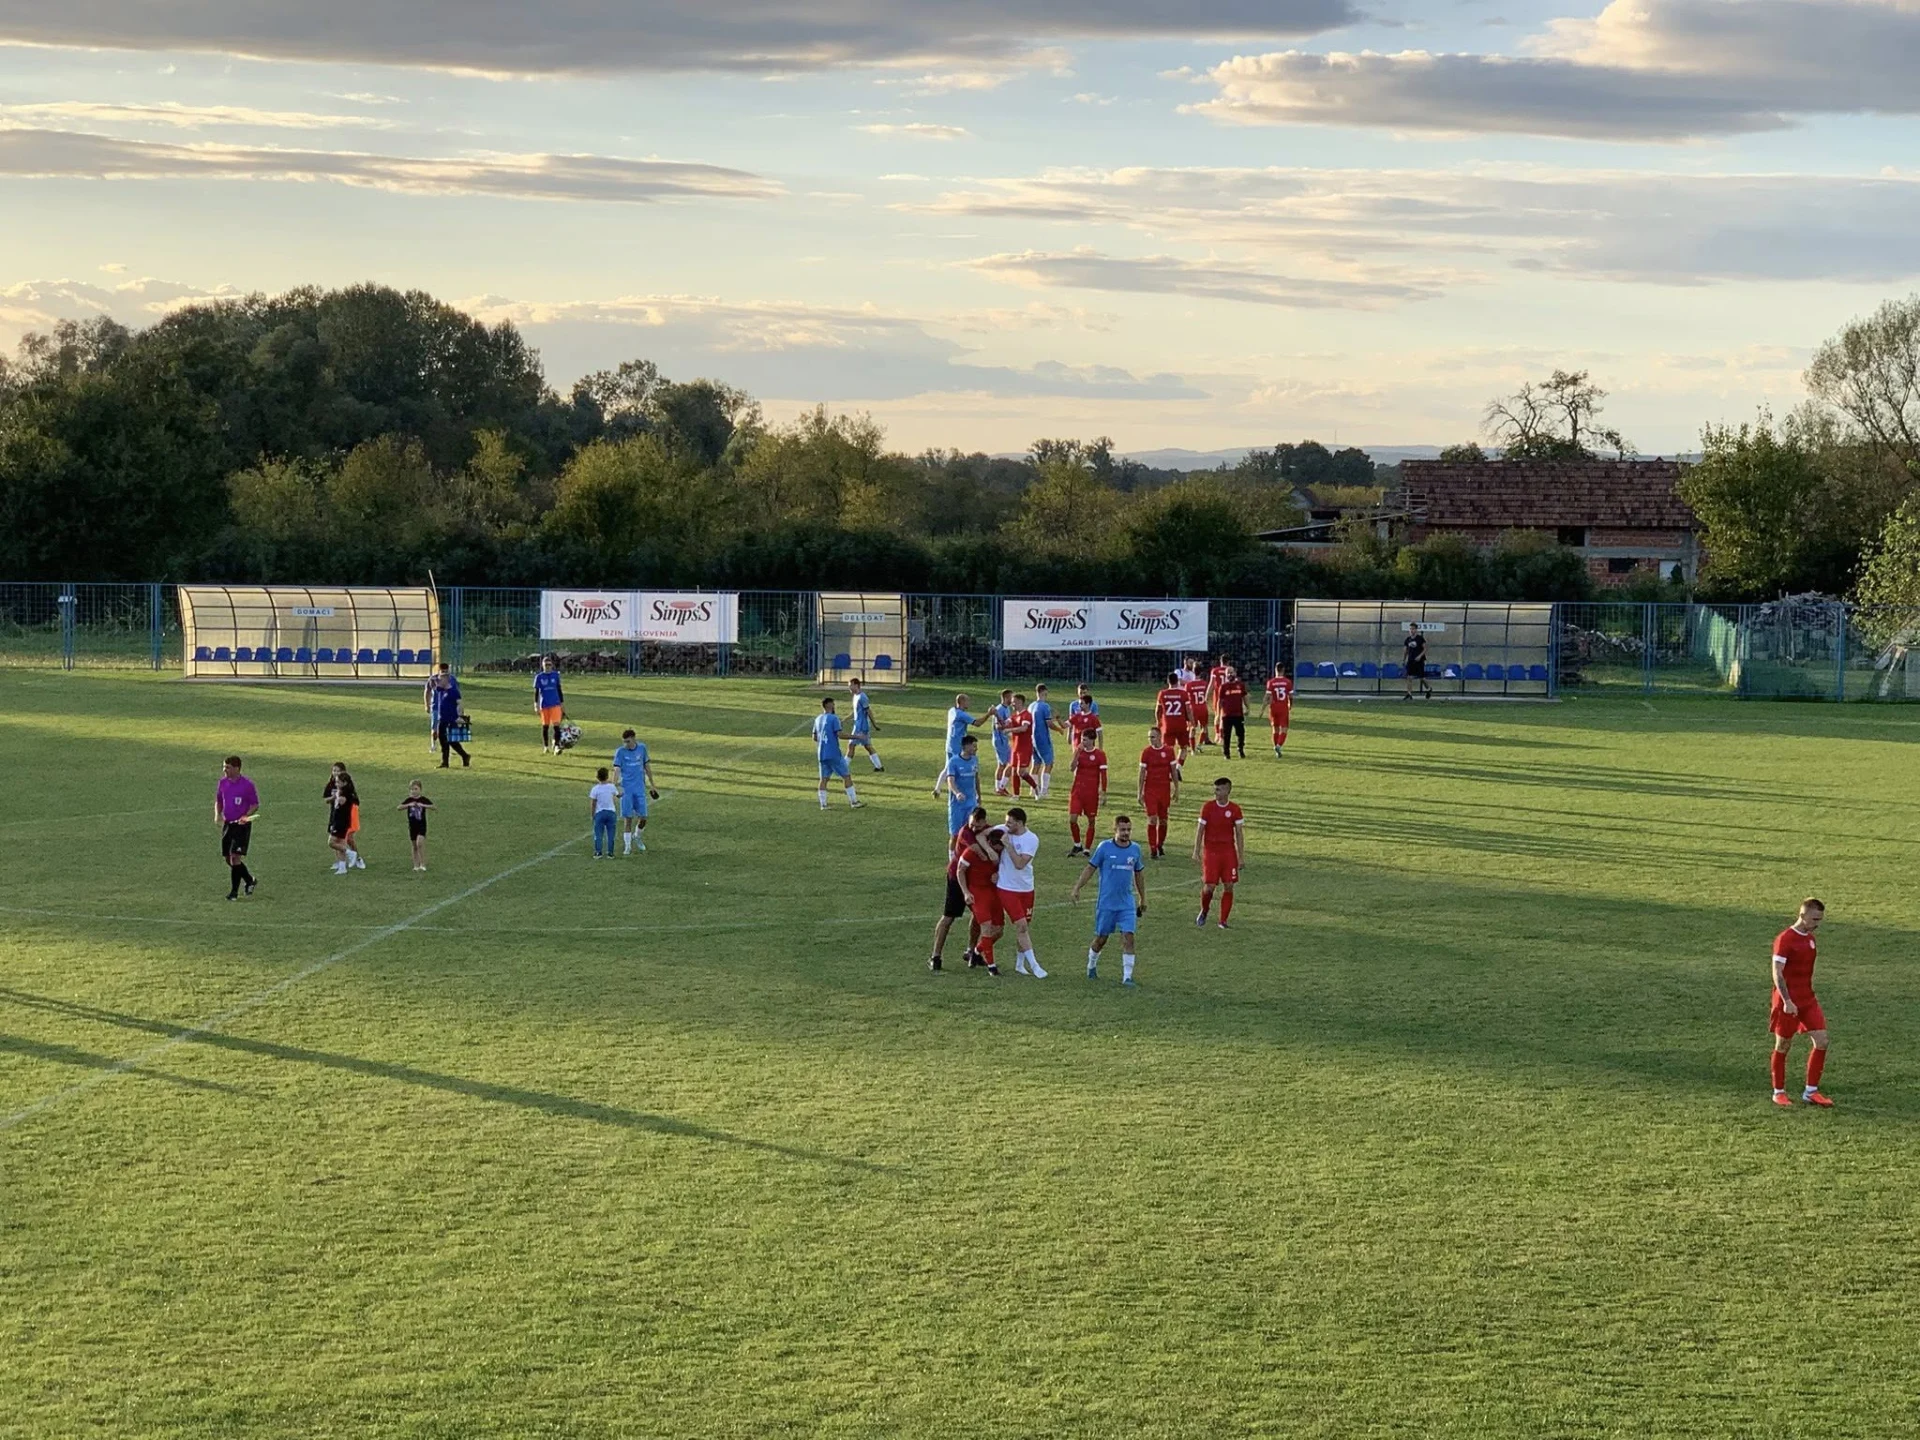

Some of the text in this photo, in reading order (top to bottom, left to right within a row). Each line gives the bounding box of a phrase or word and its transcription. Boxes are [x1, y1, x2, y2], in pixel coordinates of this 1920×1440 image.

[1193, 691, 1205, 705] 15
[1274, 687, 1287, 701] 13
[1164, 701, 1182, 716] 22
